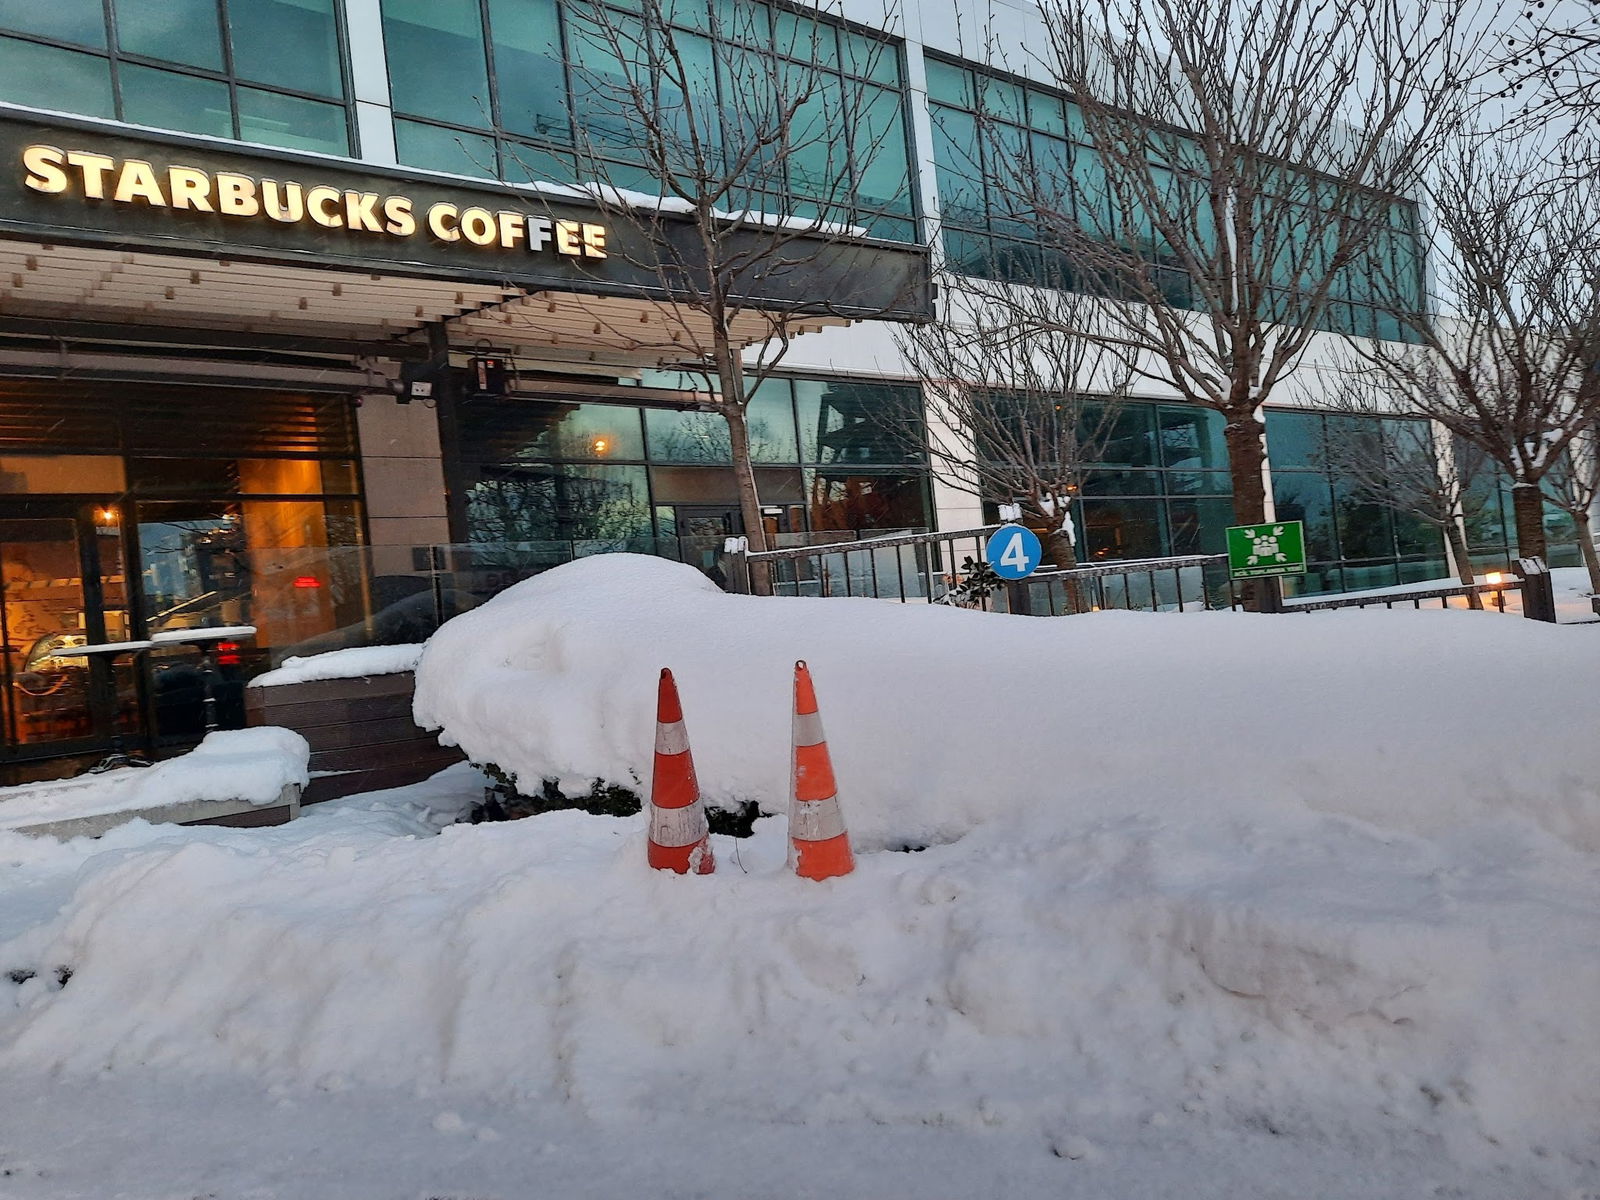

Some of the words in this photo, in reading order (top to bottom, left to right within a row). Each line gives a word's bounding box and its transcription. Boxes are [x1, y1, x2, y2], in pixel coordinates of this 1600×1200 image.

[23, 144, 416, 236] STARBUCKS
[427, 202, 607, 259] COFFEE
[1000, 532, 1029, 572] 4
